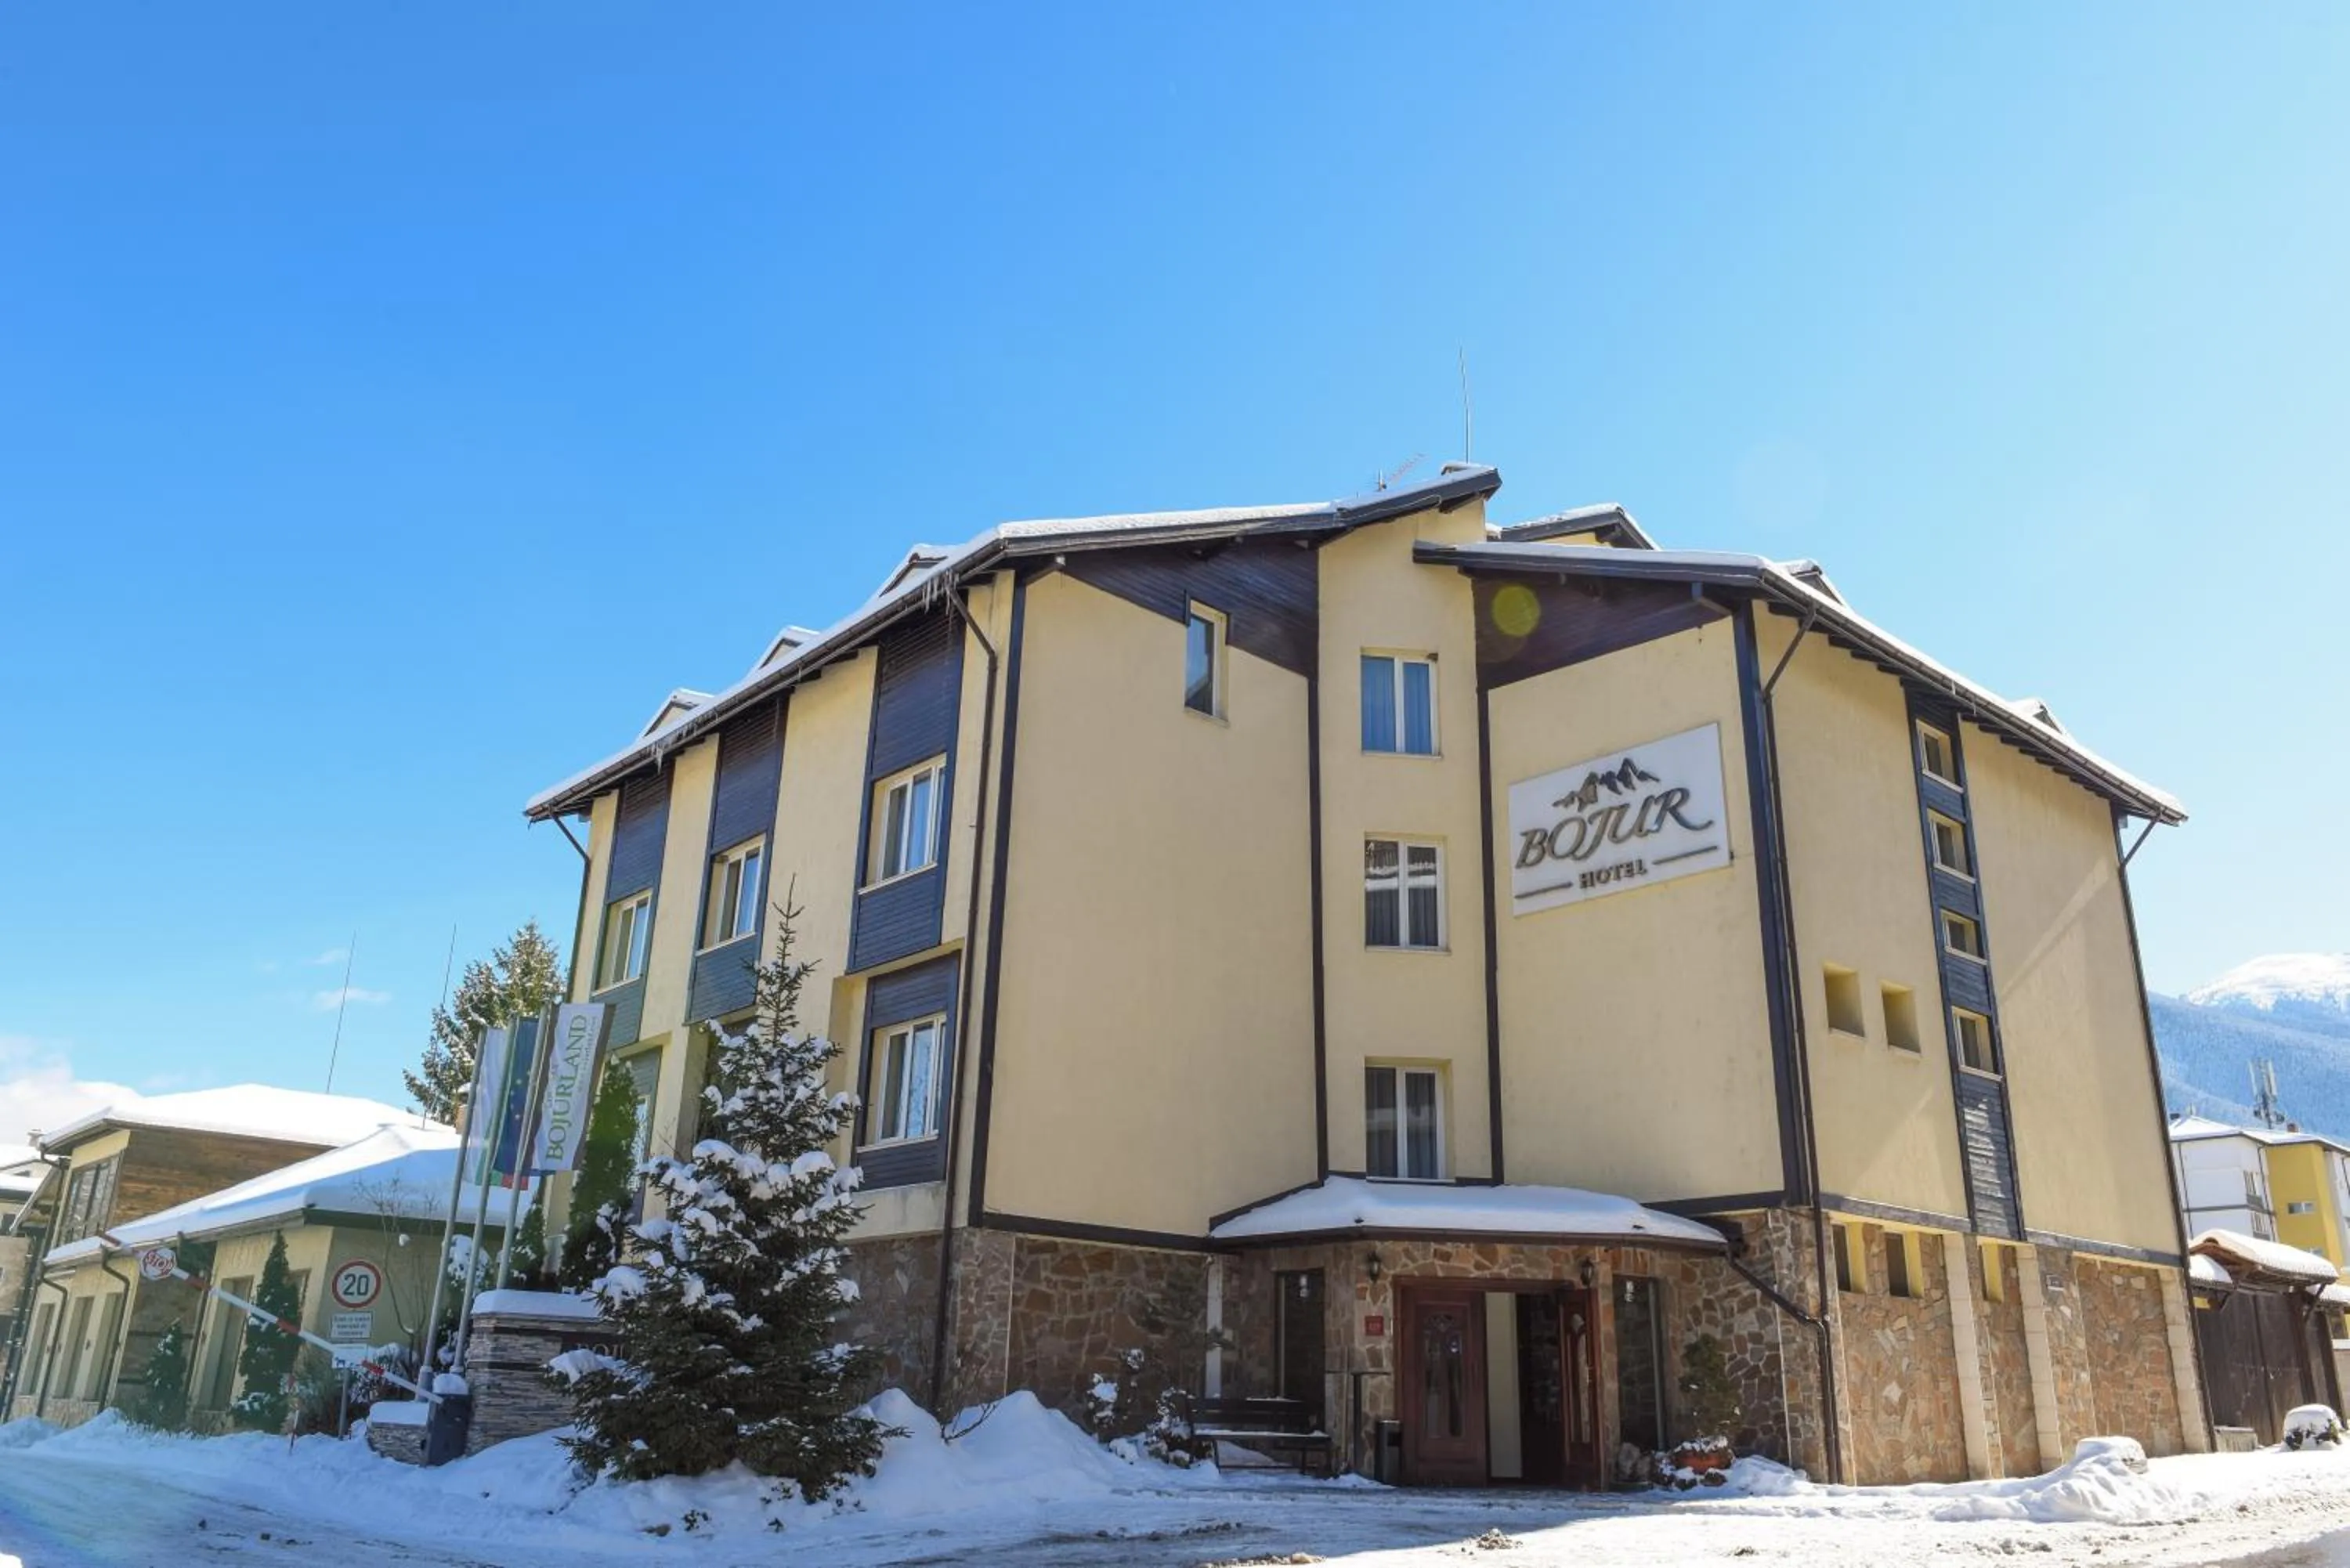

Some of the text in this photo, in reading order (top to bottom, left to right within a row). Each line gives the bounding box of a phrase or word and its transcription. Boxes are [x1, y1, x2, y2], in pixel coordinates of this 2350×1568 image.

[1515, 787, 1714, 869] BOJUR
[1579, 858, 1648, 889] HOTEL
[546, 1014, 586, 1161] BOJURLAND
[342, 1273, 370, 1296] 20
